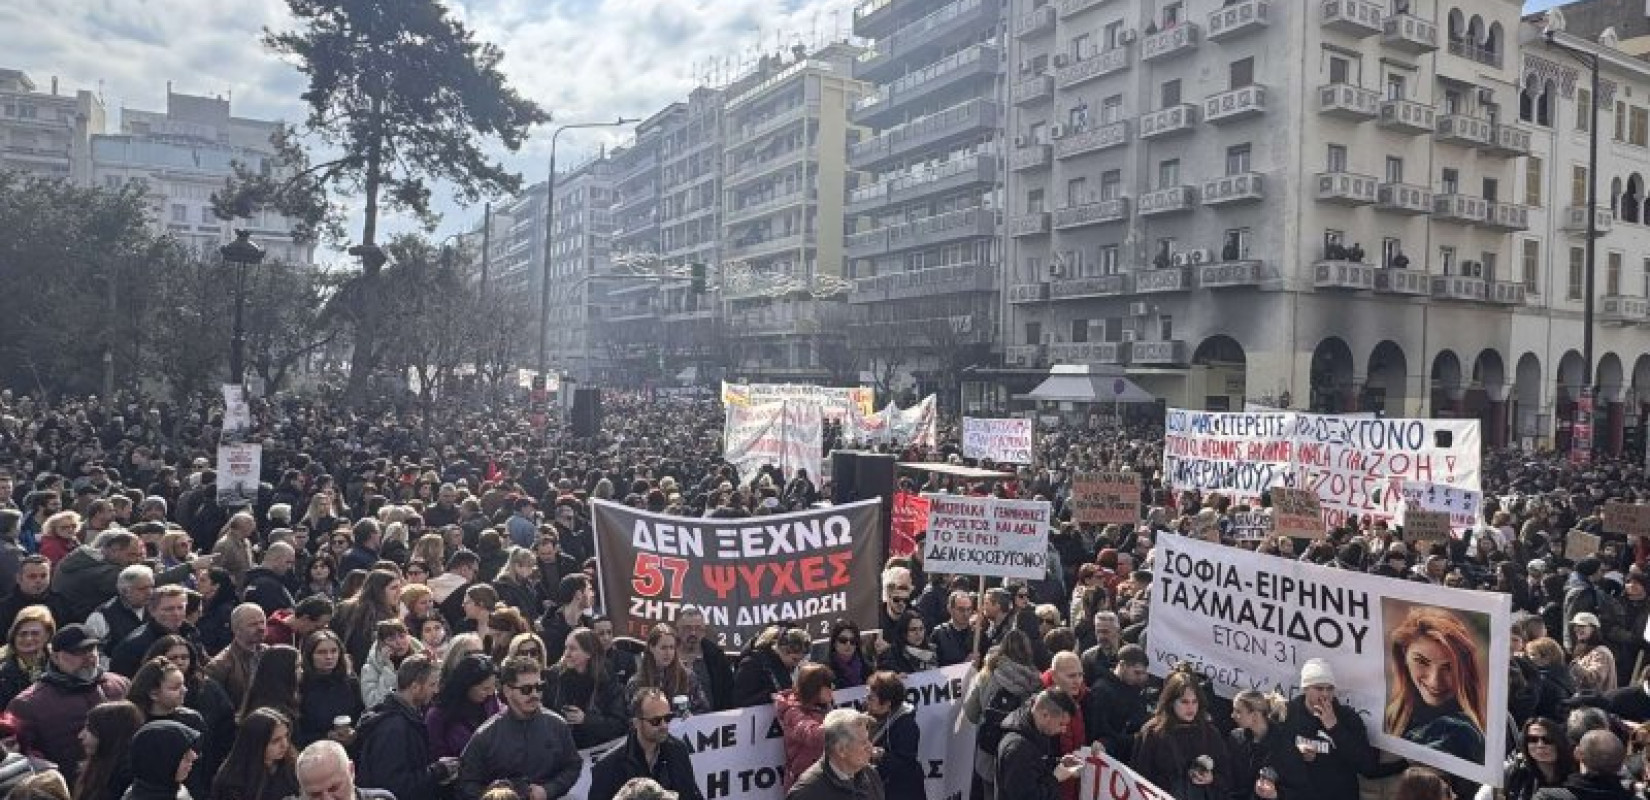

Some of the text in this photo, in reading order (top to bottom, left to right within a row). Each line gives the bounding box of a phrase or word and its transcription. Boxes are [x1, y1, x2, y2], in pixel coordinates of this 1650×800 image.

[1220, 414, 1285, 436] ΣΤΕΡΕΙΤΕ
[632, 515, 853, 558] ΔΕΝ ΞΕΧΝΩ
[932, 529, 952, 542] ΤΟ
[632, 551, 853, 598] 57 ΨΥΧΕΣ
[1162, 549, 1370, 620] ΣΟΦΙΑ-ΕΙΡΗΝΗ
[736, 591, 847, 626] ΔΙΚΑΙΩΣΗ
[1161, 577, 1369, 654] ΤΑΧΜΑΖΙΔΟΥ
[1212, 625, 1298, 666] ΕΤΩΝ 31
[904, 678, 962, 706] ΟΥΜΕ
